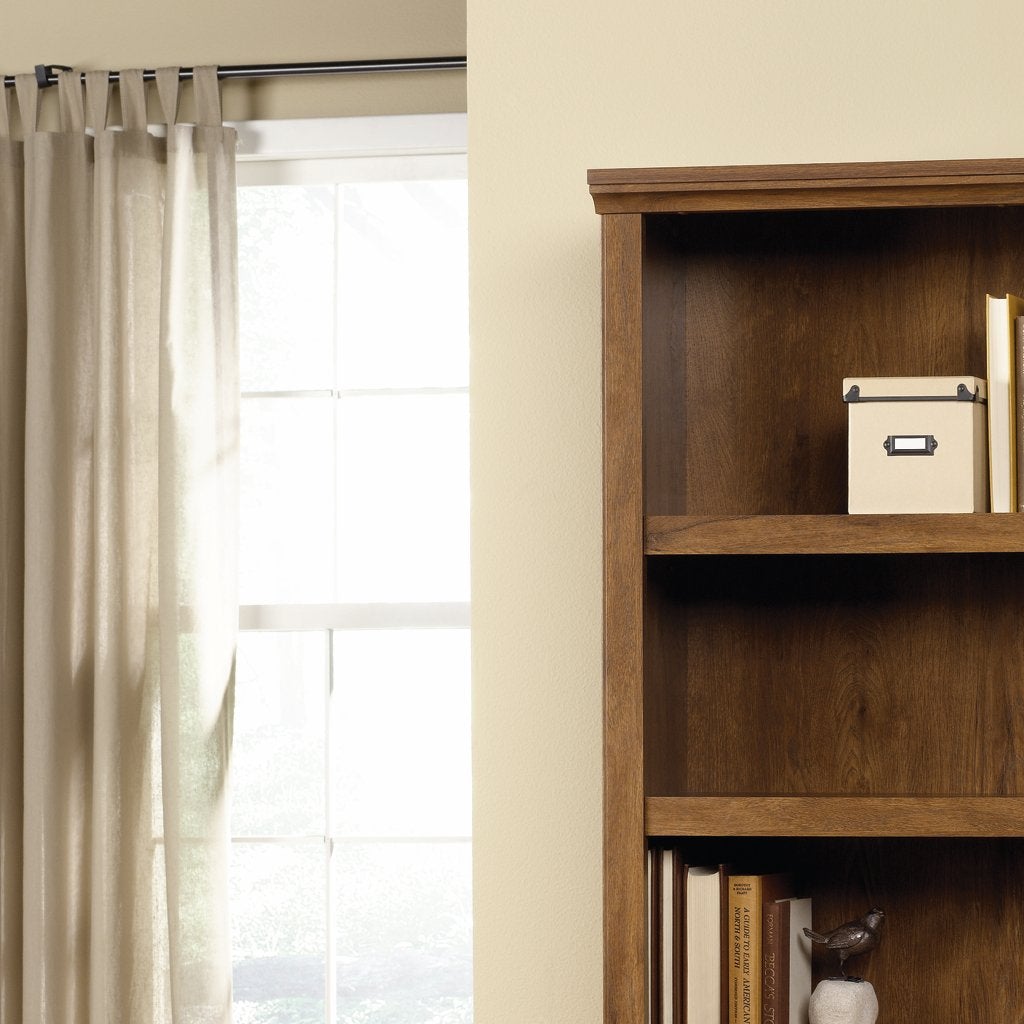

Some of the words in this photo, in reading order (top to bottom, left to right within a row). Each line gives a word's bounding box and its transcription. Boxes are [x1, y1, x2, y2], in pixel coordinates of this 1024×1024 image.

[734, 906, 742, 934] NORTH
[743, 914, 751, 938] GUIDE
[734, 943, 742, 969] SOUTH
[743, 940, 751, 951] TO
[743, 952, 751, 975] EARLY
[743, 977, 751, 1024] AMERICAN
